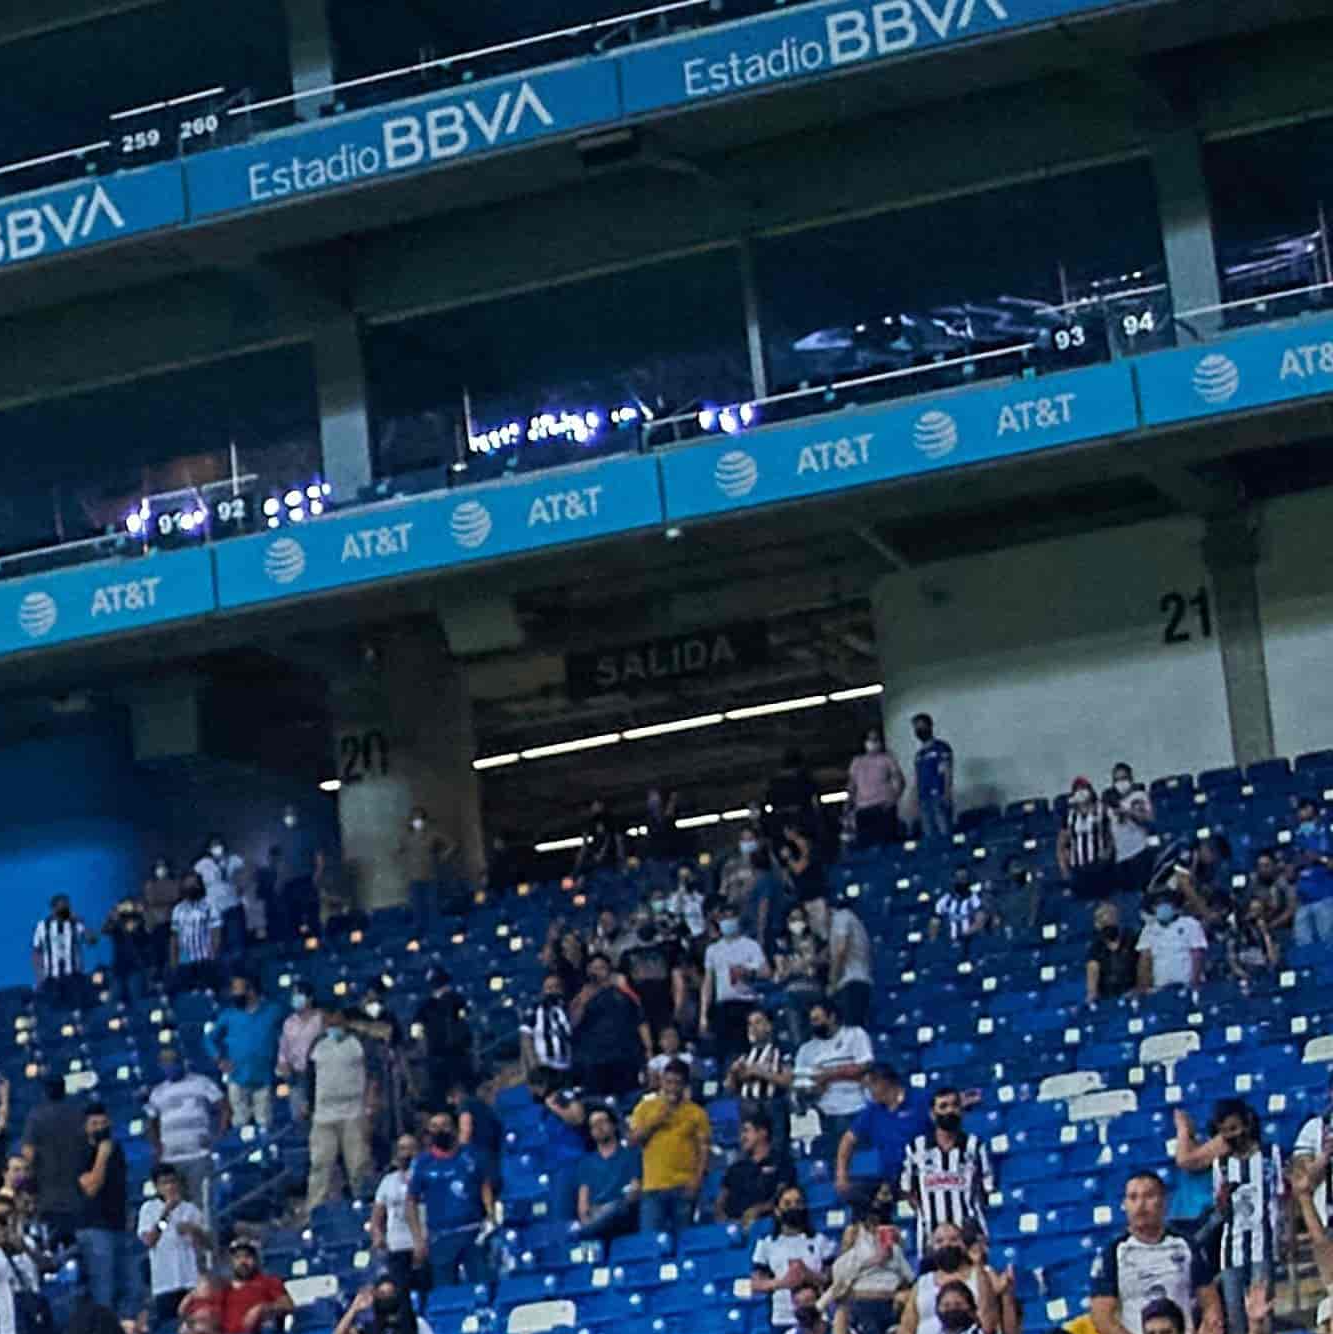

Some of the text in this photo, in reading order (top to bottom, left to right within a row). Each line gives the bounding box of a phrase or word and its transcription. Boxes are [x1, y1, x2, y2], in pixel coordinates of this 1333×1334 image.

[683, 34, 827, 97] Estadio
[121, 129, 162, 153] 259
[180, 114, 220, 140] 260
[247, 82, 553, 201] Estadio BBVA
[1054, 325, 1086, 350] 93
[1123, 310, 1155, 336] 94
[90, 577, 161, 618] AT&T
[341, 522, 413, 563] AT&T
[527, 487, 602, 528] AT&T
[796, 432, 876, 476] AT&T
[995, 394, 1075, 438] AT&T
[217, 499, 245, 521] 92
[1159, 585, 1215, 645] 21
[596, 633, 737, 687] SALIDA
[341, 731, 388, 784] 20
